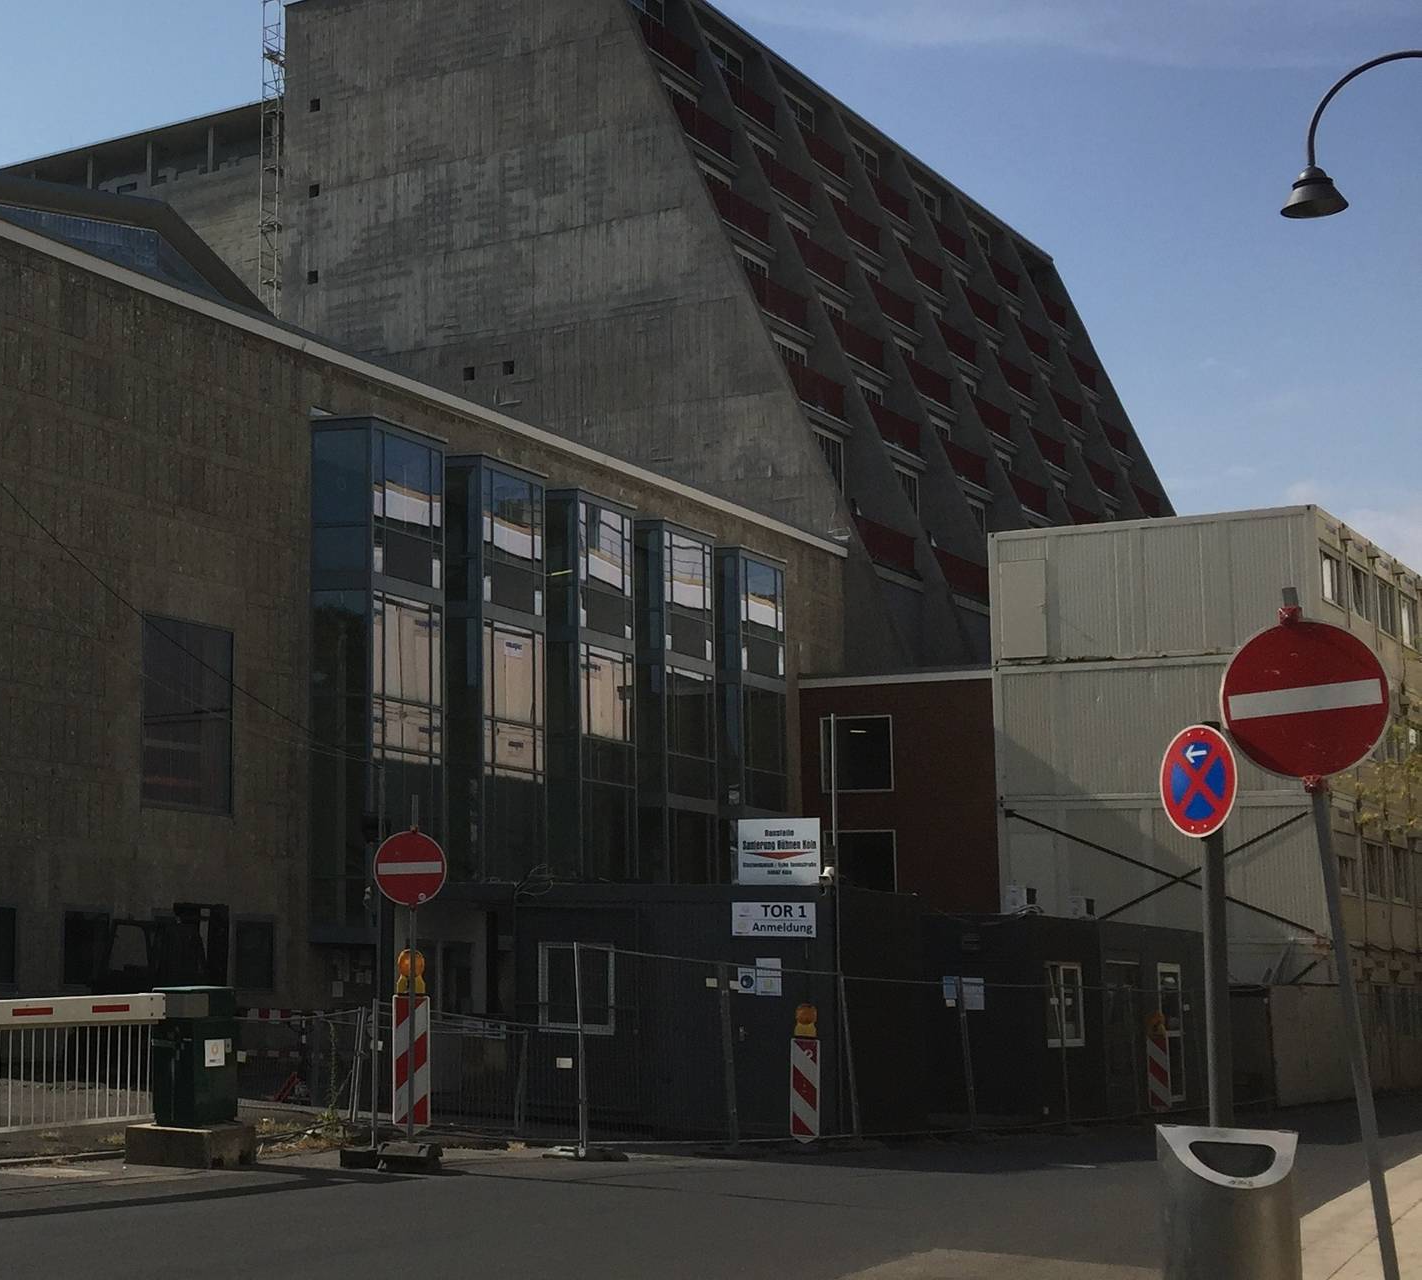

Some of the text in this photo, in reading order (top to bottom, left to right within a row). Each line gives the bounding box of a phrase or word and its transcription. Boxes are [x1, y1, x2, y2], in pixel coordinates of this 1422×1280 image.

[742, 840, 776, 851] Sanierung
[760, 904, 807, 919] TOR 1
[752, 922, 813, 935] Anmeldung
